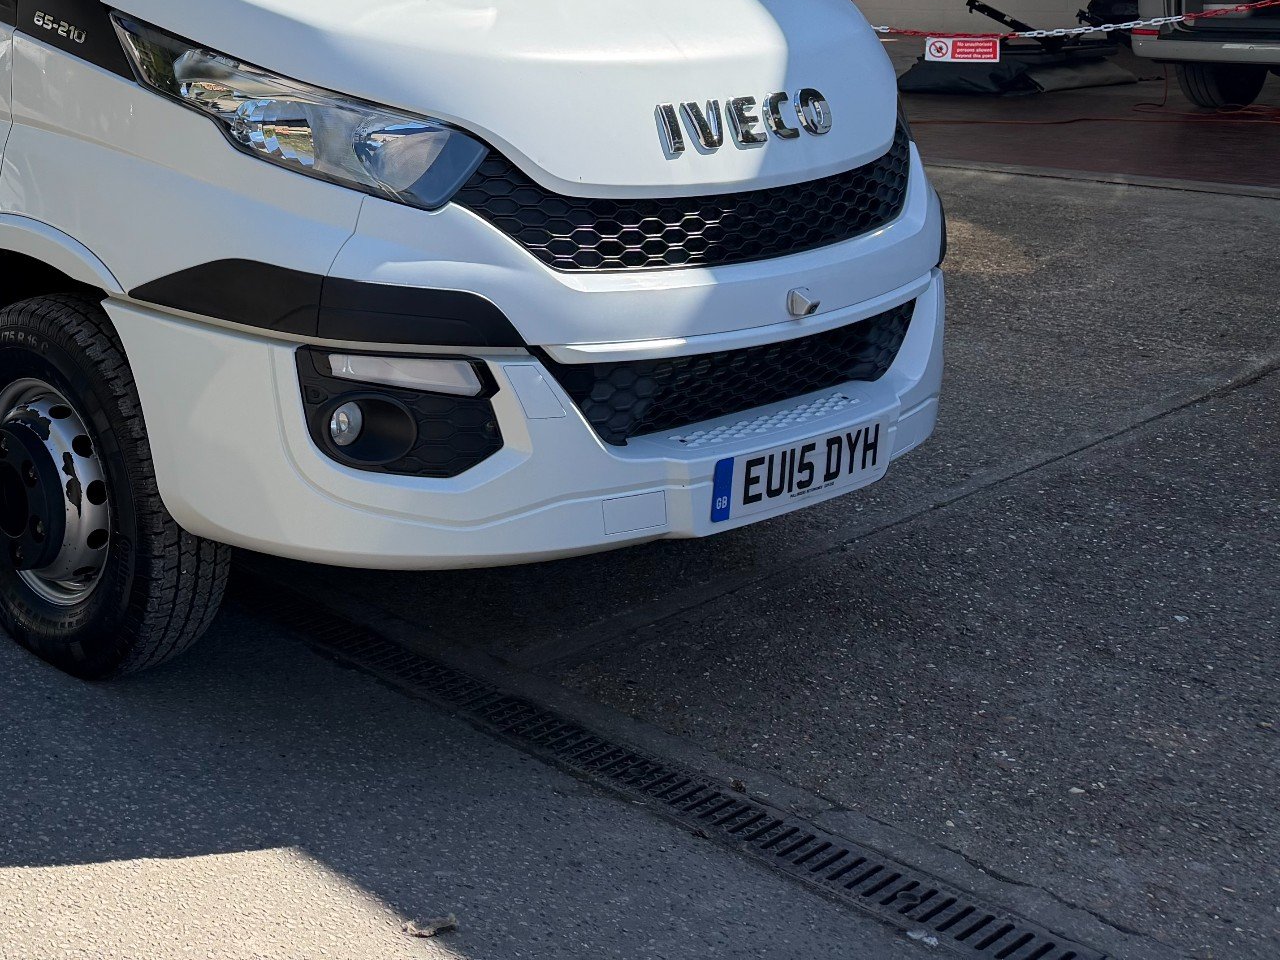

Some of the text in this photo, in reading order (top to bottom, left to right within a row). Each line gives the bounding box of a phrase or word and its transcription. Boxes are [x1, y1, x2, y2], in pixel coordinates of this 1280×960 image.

[33, 10, 87, 44] 65-210
[654, 88, 832, 156] IVECO
[743, 423, 880, 505] EU15 DYH
[716, 496, 728, 510] GB
